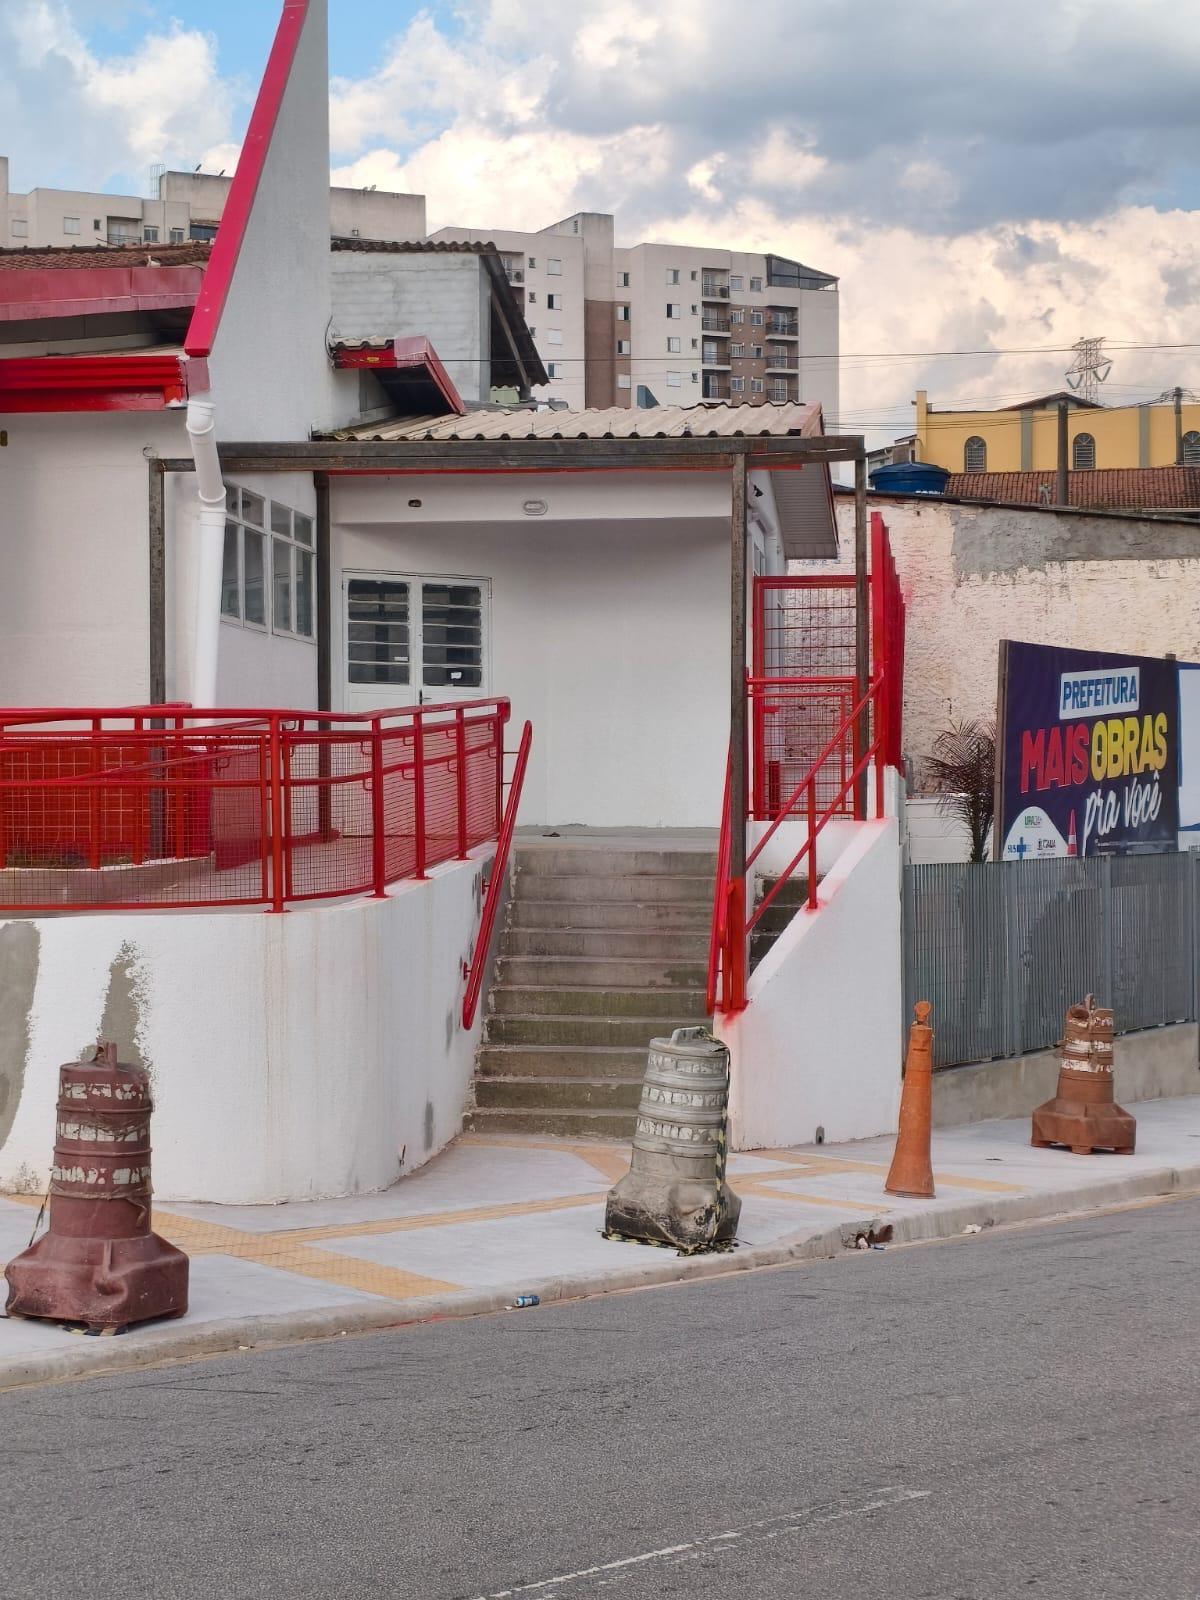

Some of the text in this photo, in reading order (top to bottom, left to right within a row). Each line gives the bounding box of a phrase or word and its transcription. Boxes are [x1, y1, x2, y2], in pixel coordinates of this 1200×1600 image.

[1062, 676, 1137, 710] PREFEITURA
[1021, 712, 1168, 793] MAIS OBRAS
[1083, 789, 1120, 857] pra
